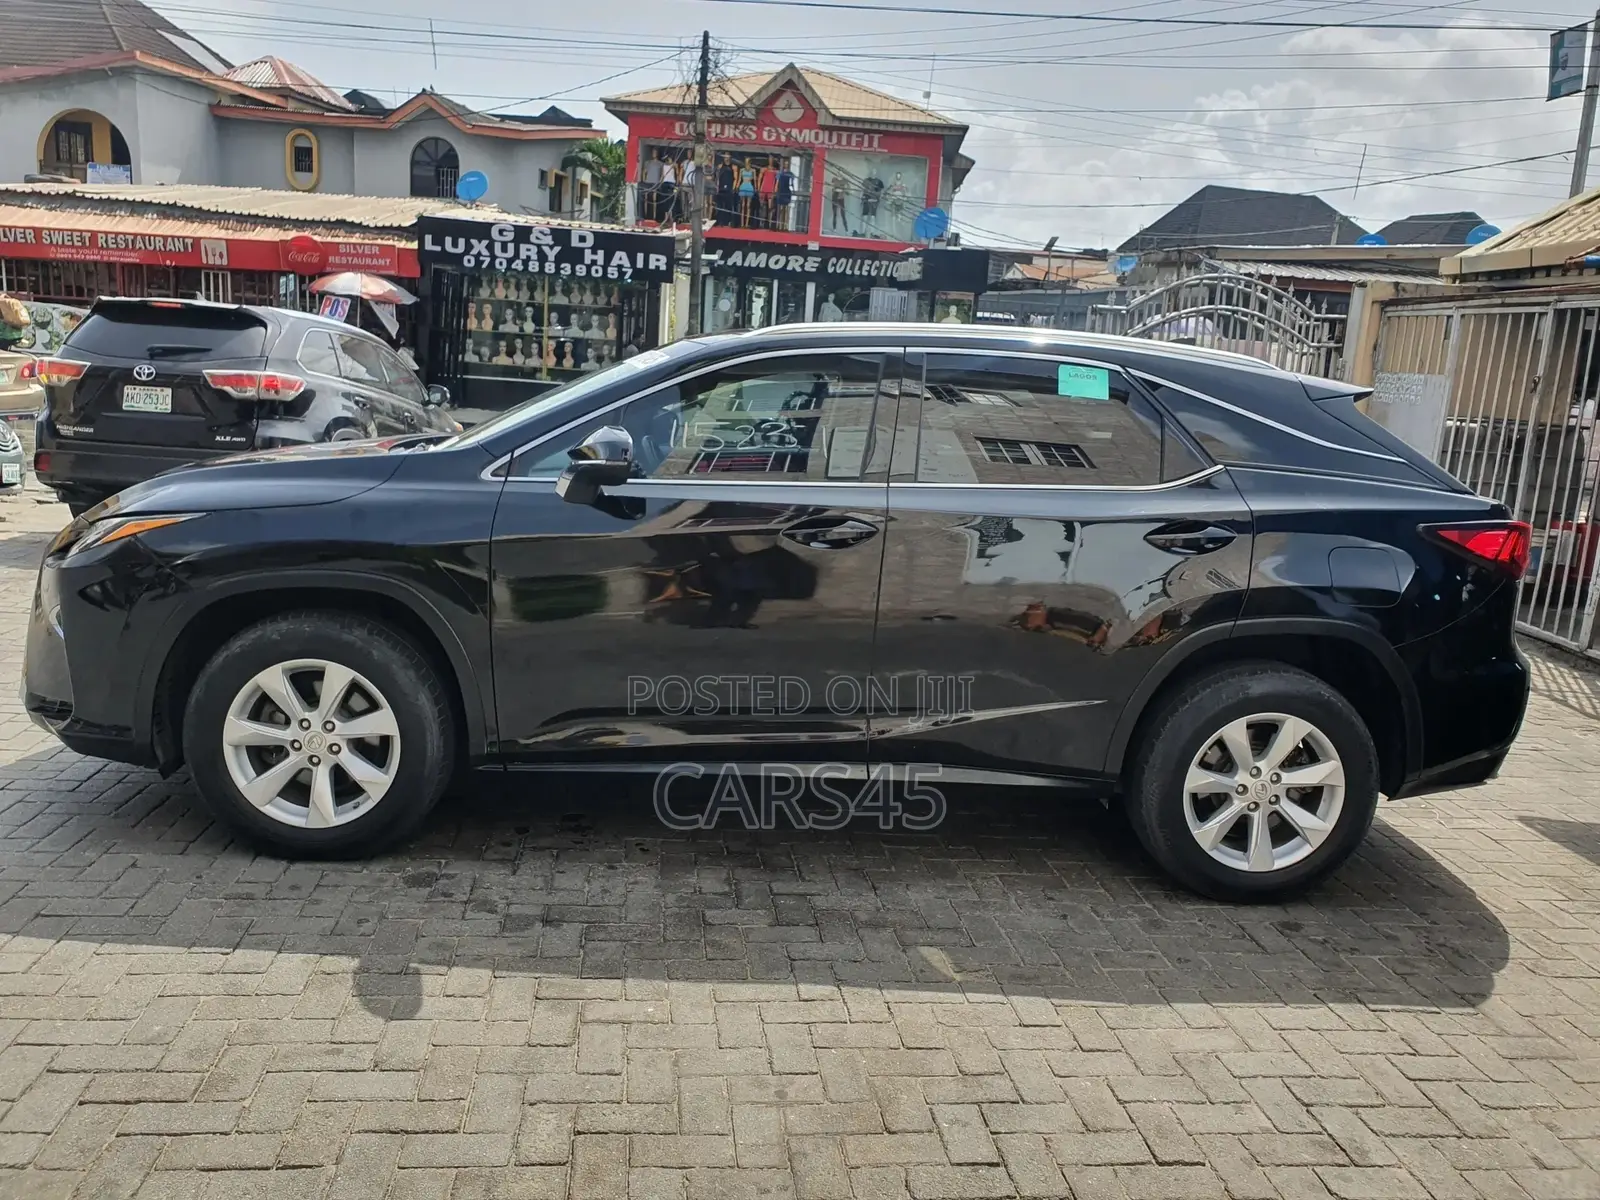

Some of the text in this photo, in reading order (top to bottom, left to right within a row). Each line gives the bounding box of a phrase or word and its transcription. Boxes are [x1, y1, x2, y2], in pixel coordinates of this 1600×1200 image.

[42, 229, 92, 247] SWEET
[97, 233, 194, 253] RESTAURANT
[491, 224, 595, 248] G & D
[328, 255, 392, 267] RESTAURANT
[339, 244, 380, 255] SILVER
[425, 234, 668, 271] LUXURY HAIR
[463, 254, 634, 280] 07048839057
[320, 295, 349, 318] POS
